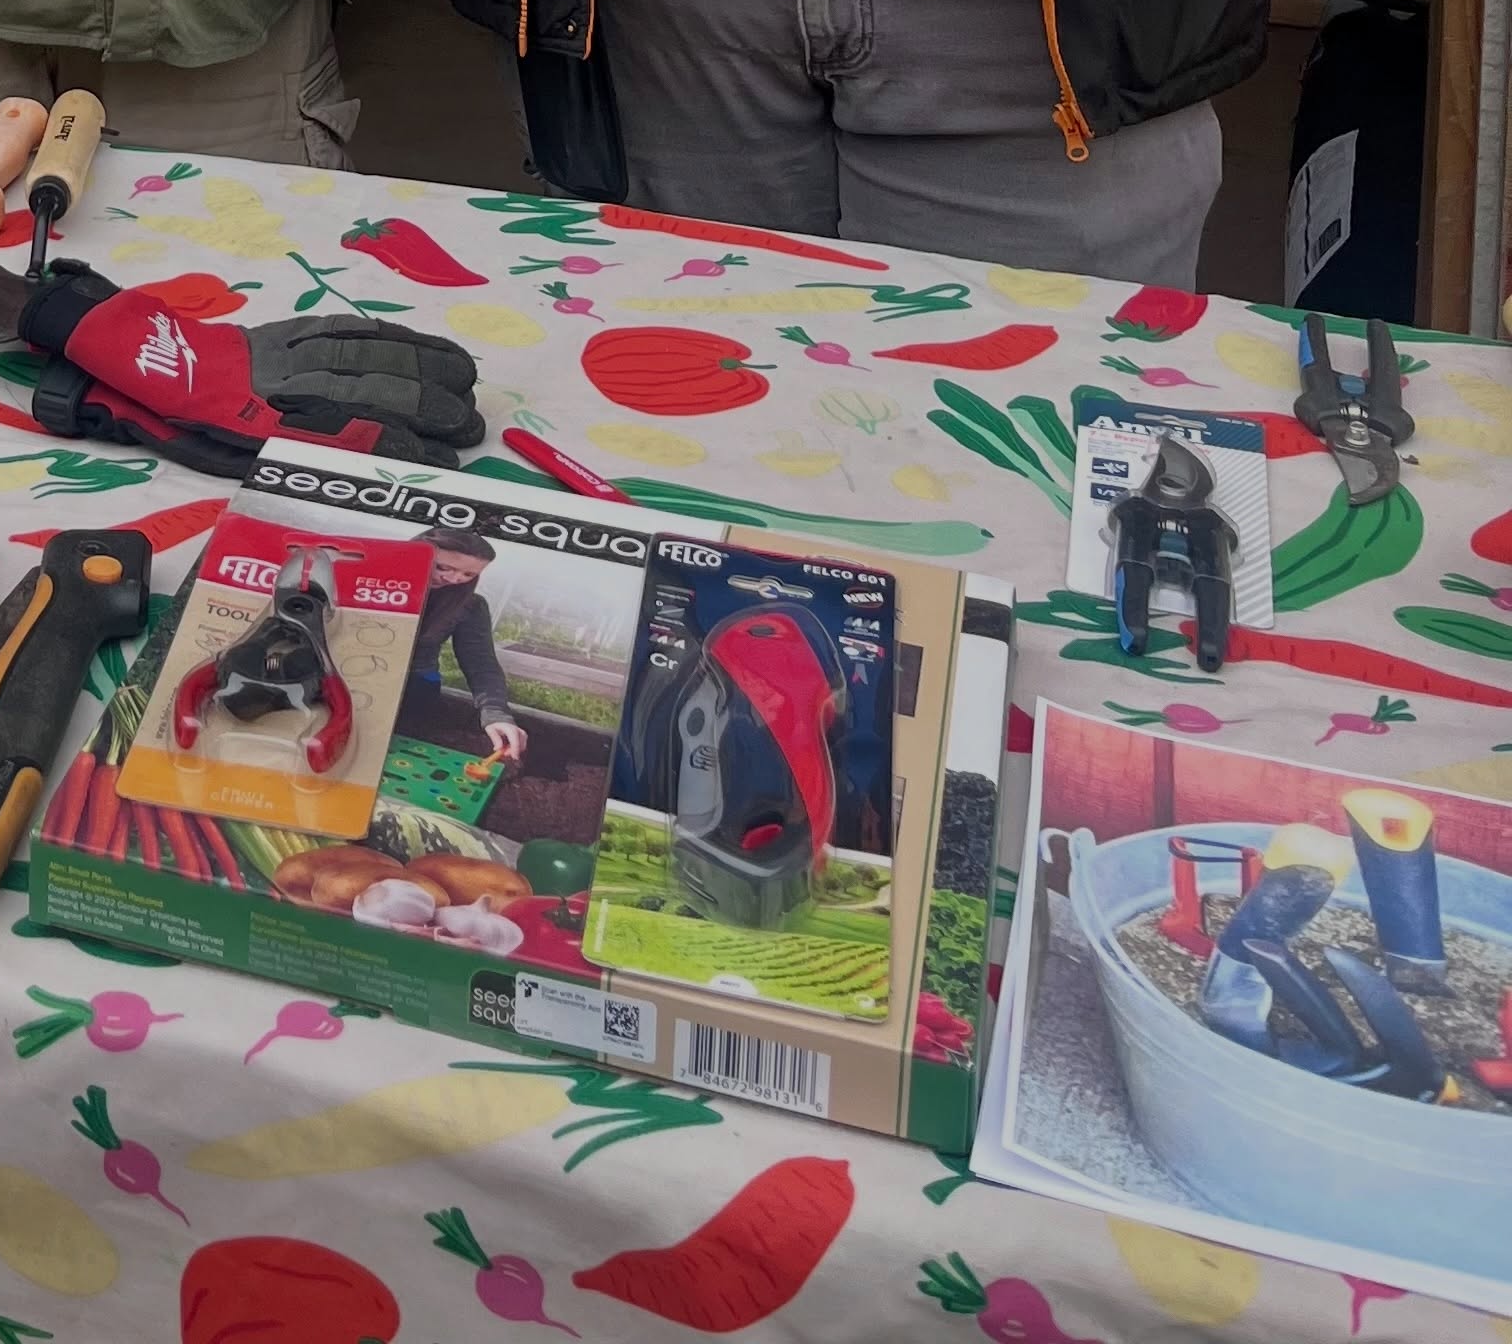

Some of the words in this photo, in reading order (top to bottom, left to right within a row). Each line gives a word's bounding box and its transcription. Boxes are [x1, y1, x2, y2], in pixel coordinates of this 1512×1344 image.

[54, 115, 76, 141] Anvil
[254, 465, 476, 528] seeding
[499, 514, 646, 559] squa
[658, 541, 722, 567] FELCO
[218, 556, 281, 589] FELC
[803, 564, 853, 581] FELCO
[857, 574, 887, 586] 601
[356, 576, 411, 591] FELCO
[353, 588, 408, 605] 330
[843, 591, 884, 603] NEW
[48, 884, 83, 902] Copyright
[168, 935, 190, 949] Made
[187, 929, 224, 946] Reserved
[680, 1068, 686, 1078] 7
[703, 1071, 748, 1094] 84672
[755, 1088, 798, 1107] 98131
[815, 1102, 823, 1113] 6
